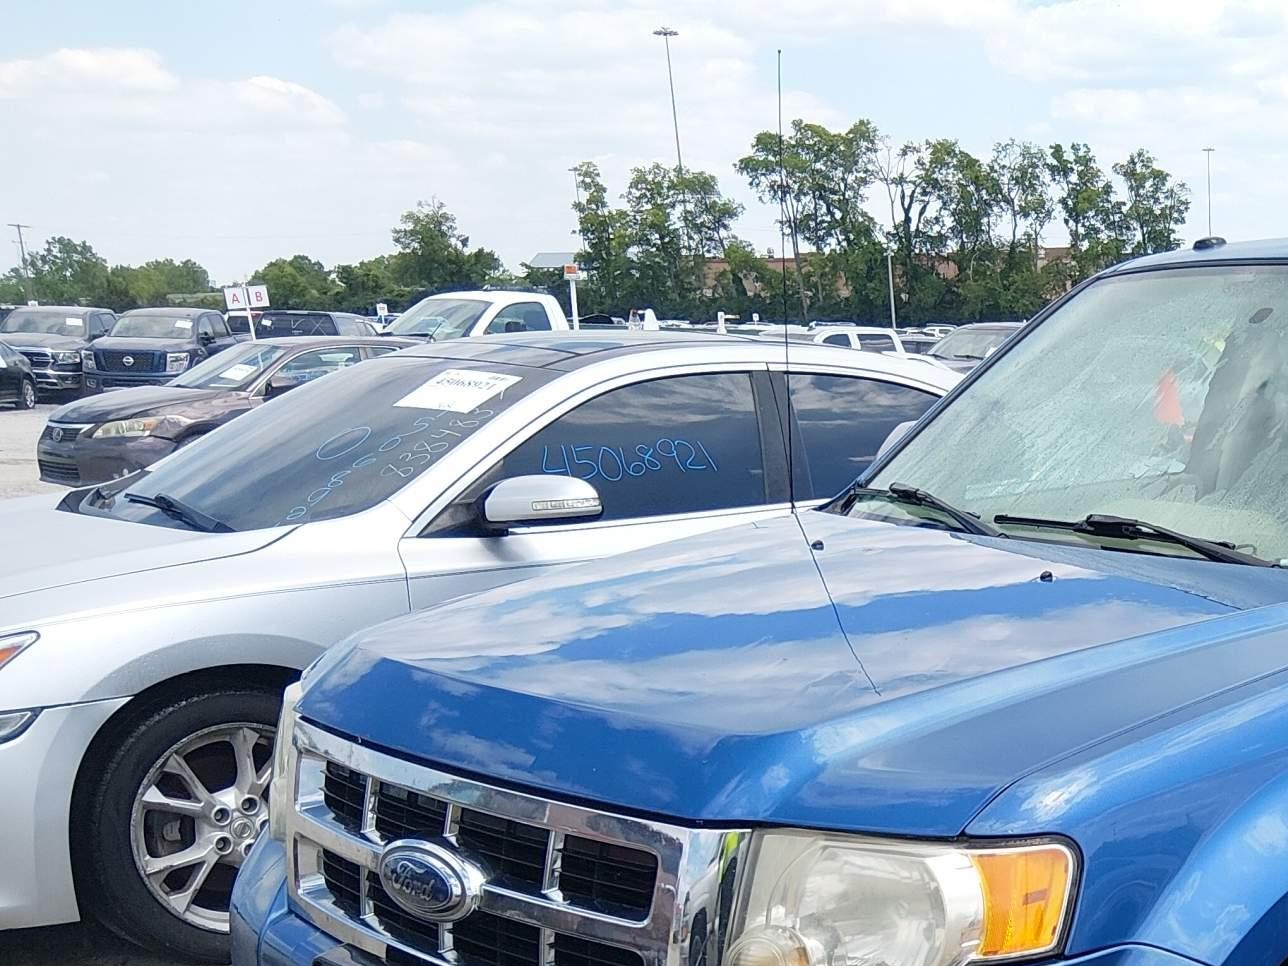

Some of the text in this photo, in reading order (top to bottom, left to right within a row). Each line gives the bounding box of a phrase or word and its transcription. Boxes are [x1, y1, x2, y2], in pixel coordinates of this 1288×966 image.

[231, 293, 241, 304] A
[255, 291, 263, 302] B
[541, 438, 718, 482] 45068921
[392, 860, 435, 901] Ford
